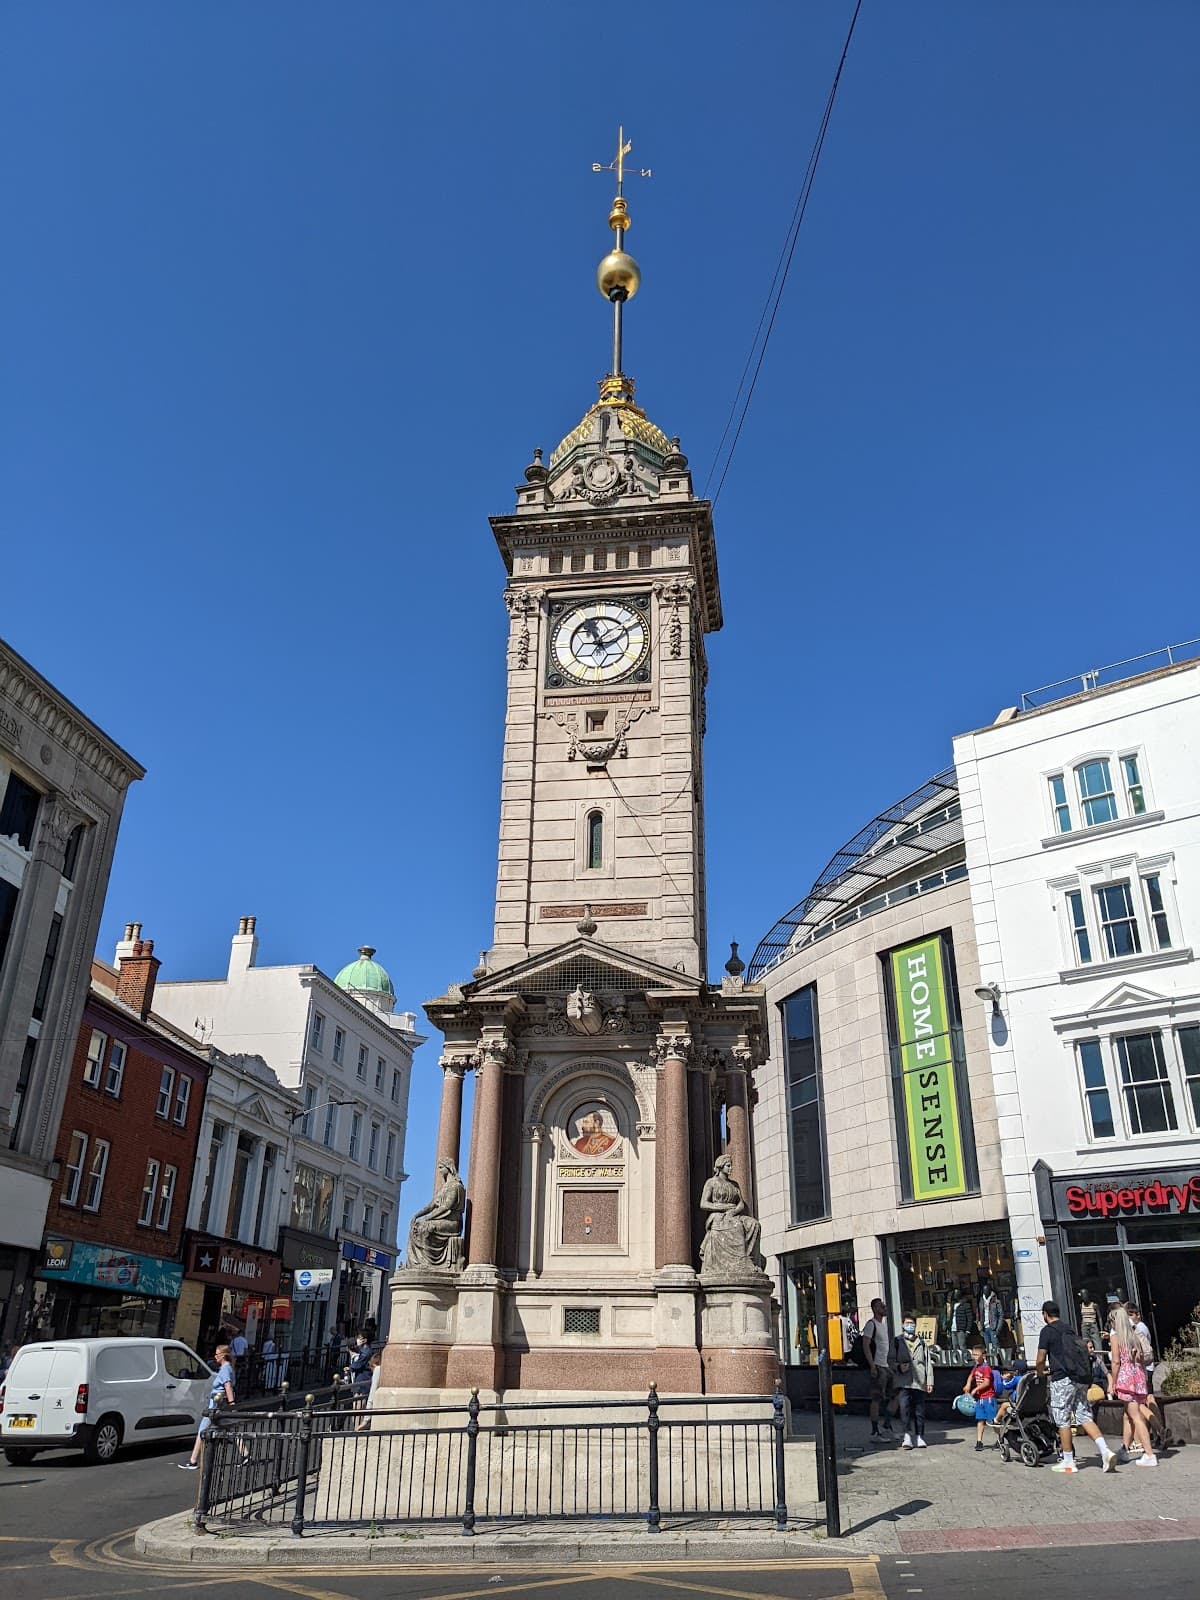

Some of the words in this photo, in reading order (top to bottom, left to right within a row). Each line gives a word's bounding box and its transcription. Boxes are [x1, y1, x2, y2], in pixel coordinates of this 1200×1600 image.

[907, 953, 936, 1060] HOME
[919, 1070, 948, 1185] SENSE
[586, 1168, 597, 1177] OF
[599, 1168, 624, 1177] WALES
[1065, 1180, 1189, 1216] Superdry
[47, 1258, 67, 1267] LEON
[220, 1255, 234, 1274] PRET
[917, 1331, 933, 1340] SALE
